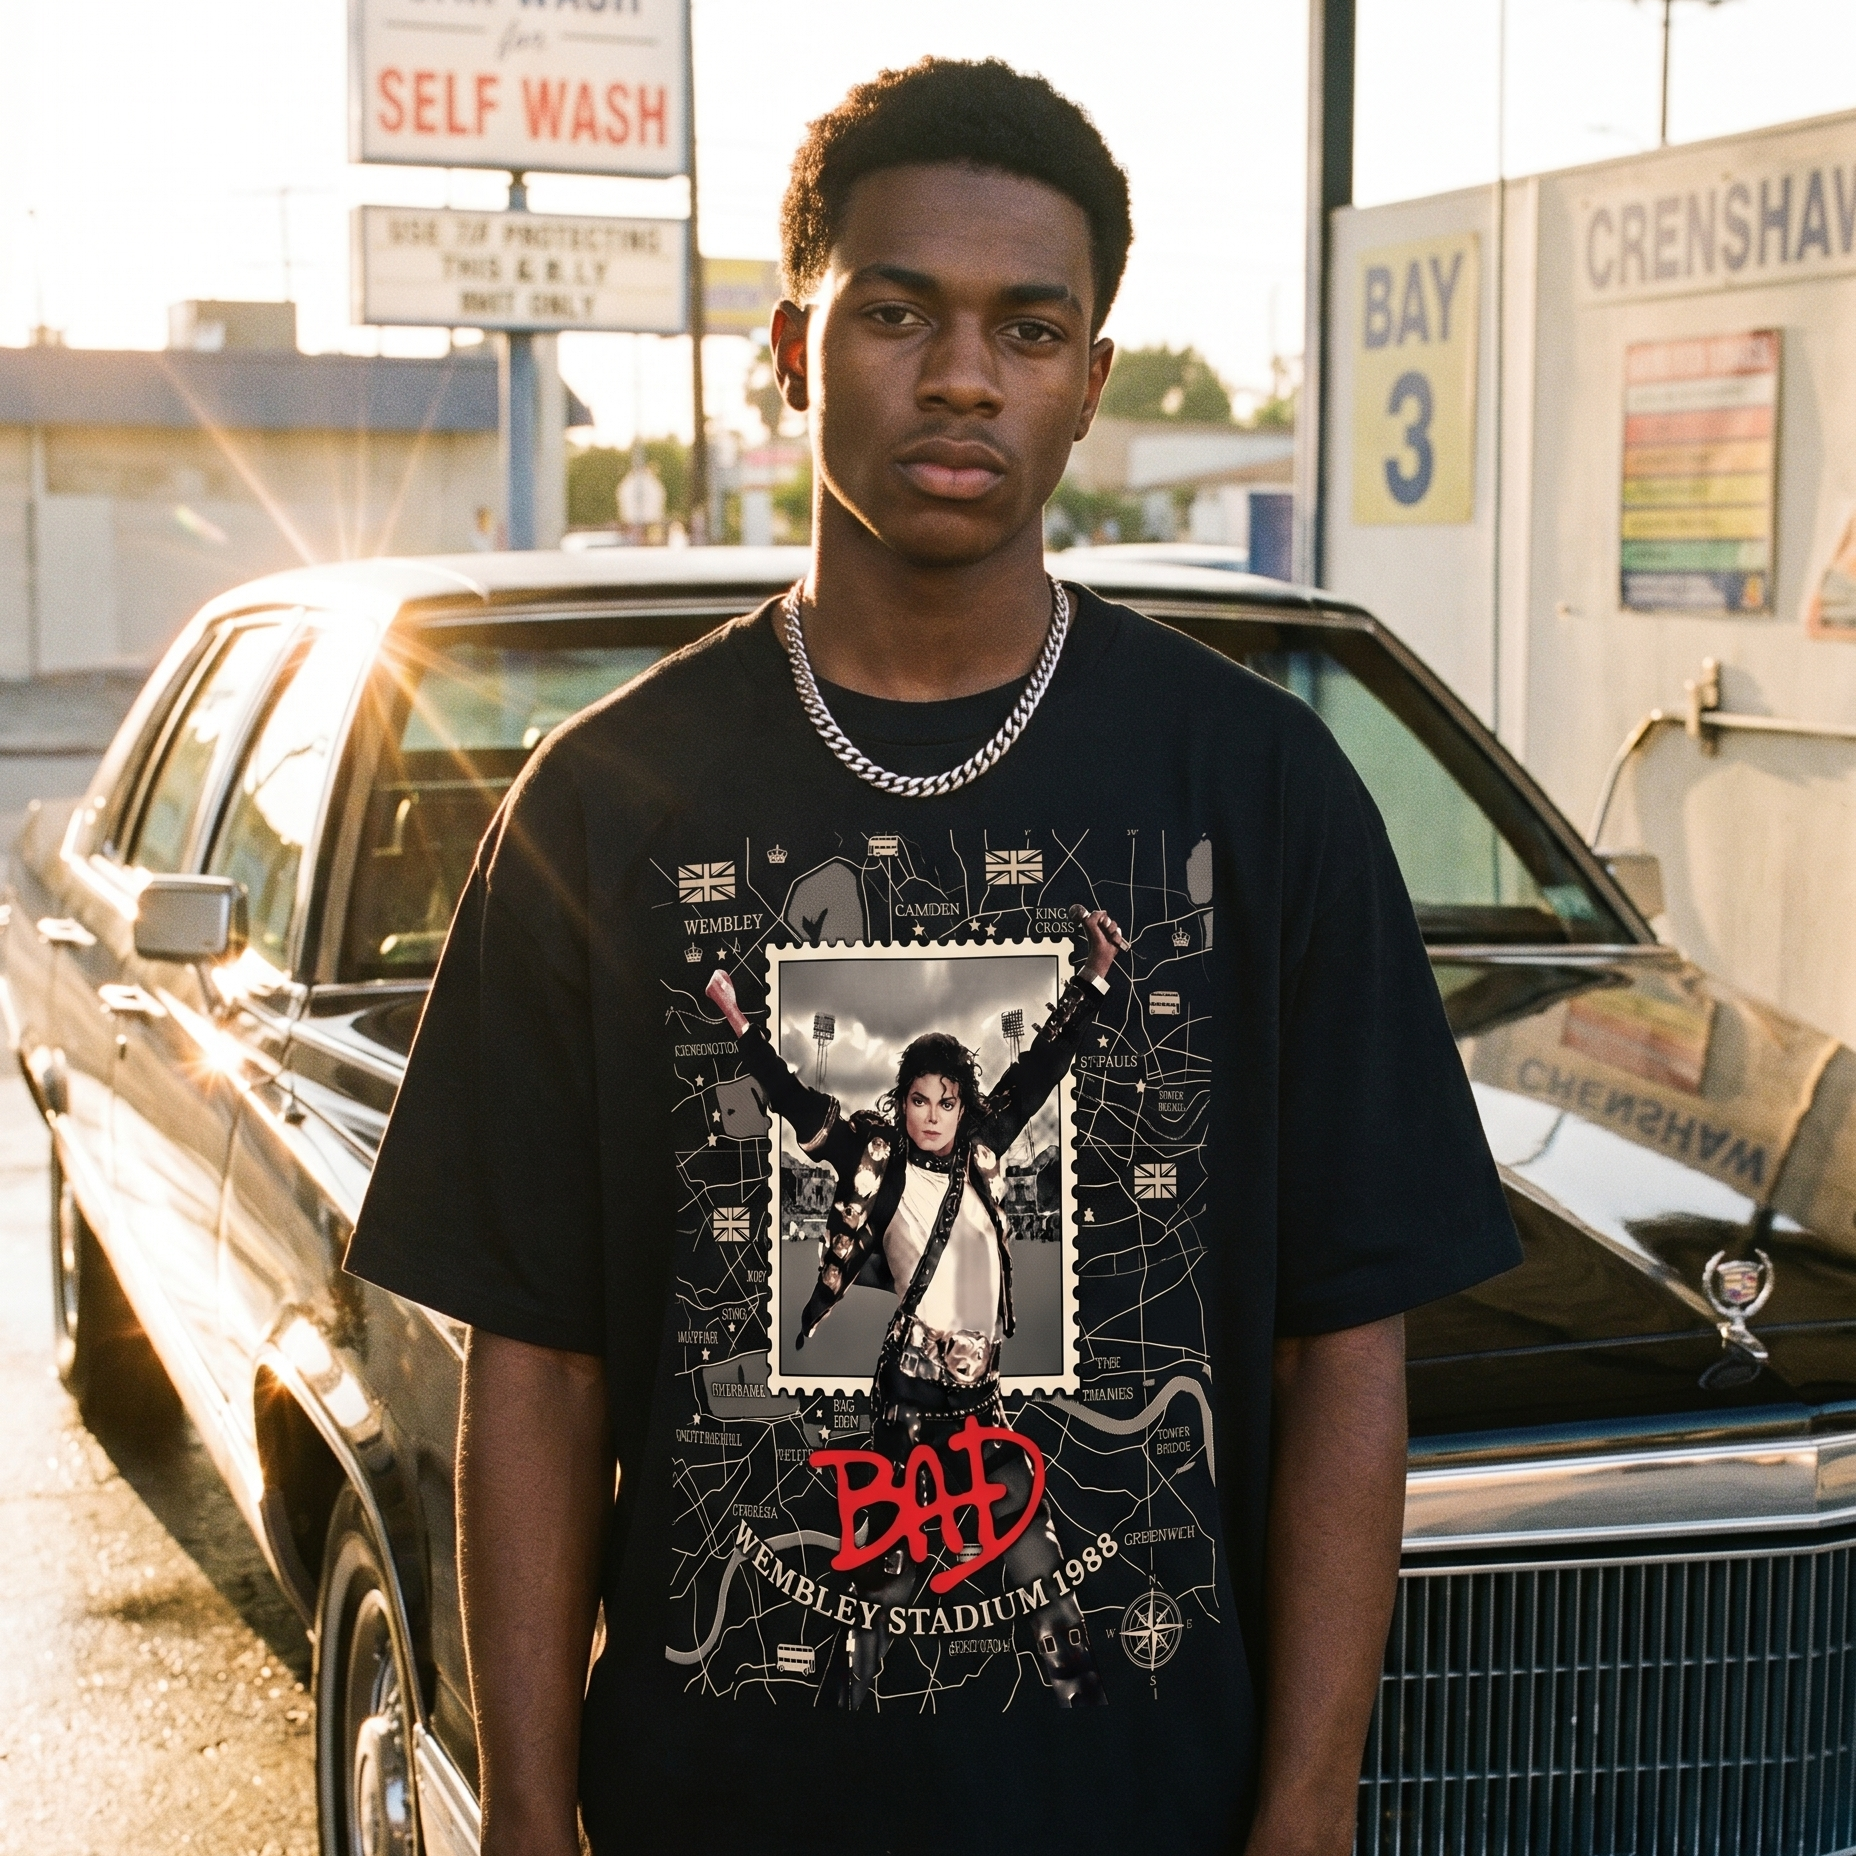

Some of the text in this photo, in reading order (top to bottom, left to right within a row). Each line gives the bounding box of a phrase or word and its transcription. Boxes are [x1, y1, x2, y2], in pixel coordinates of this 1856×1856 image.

[376, 66, 669, 149] SELF WASH
[1364, 252, 1463, 349] BAY
[1385, 370, 1434, 507] 3
[684, 913, 764, 935] WEMBLEY
[895, 902, 960, 917] CAMDEN
[809, 1415, 1045, 1594] BAD
[733, 1518, 1118, 1635] WEMBLEY STADIUM 1988
